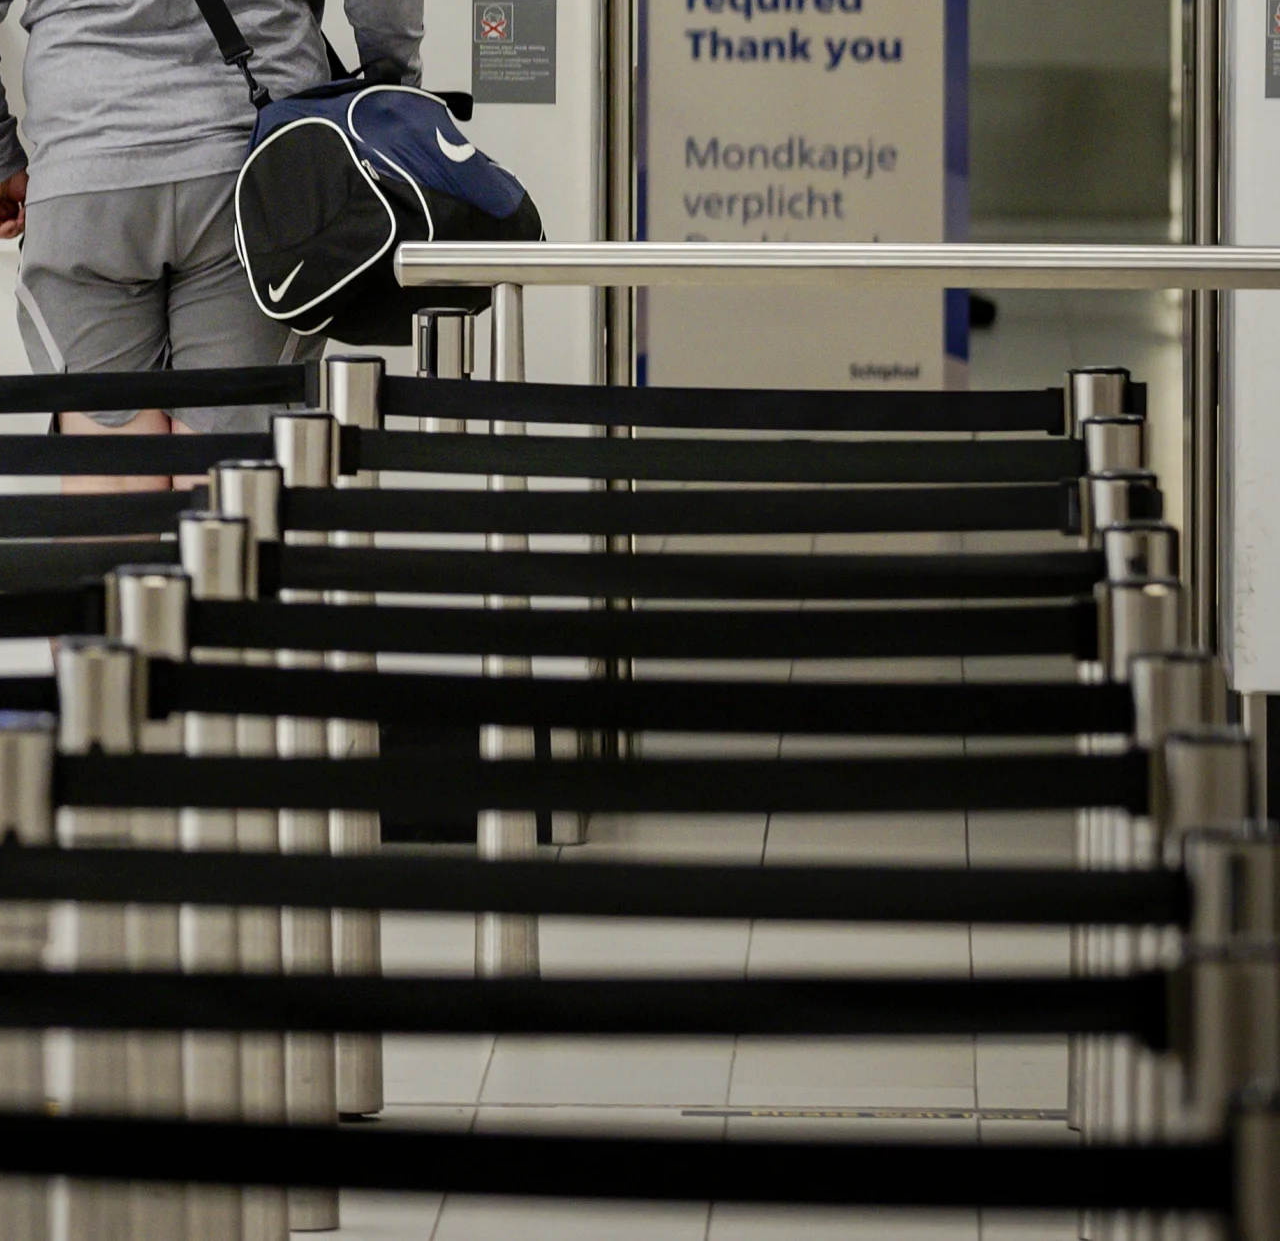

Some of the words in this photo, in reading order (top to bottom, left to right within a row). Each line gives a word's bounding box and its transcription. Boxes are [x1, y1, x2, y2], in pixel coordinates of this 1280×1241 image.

[686, 30, 808, 59] Thank
[826, 35, 902, 69] you
[686, 137, 897, 178] Mondkapje
[684, 186, 842, 225] verplicht
